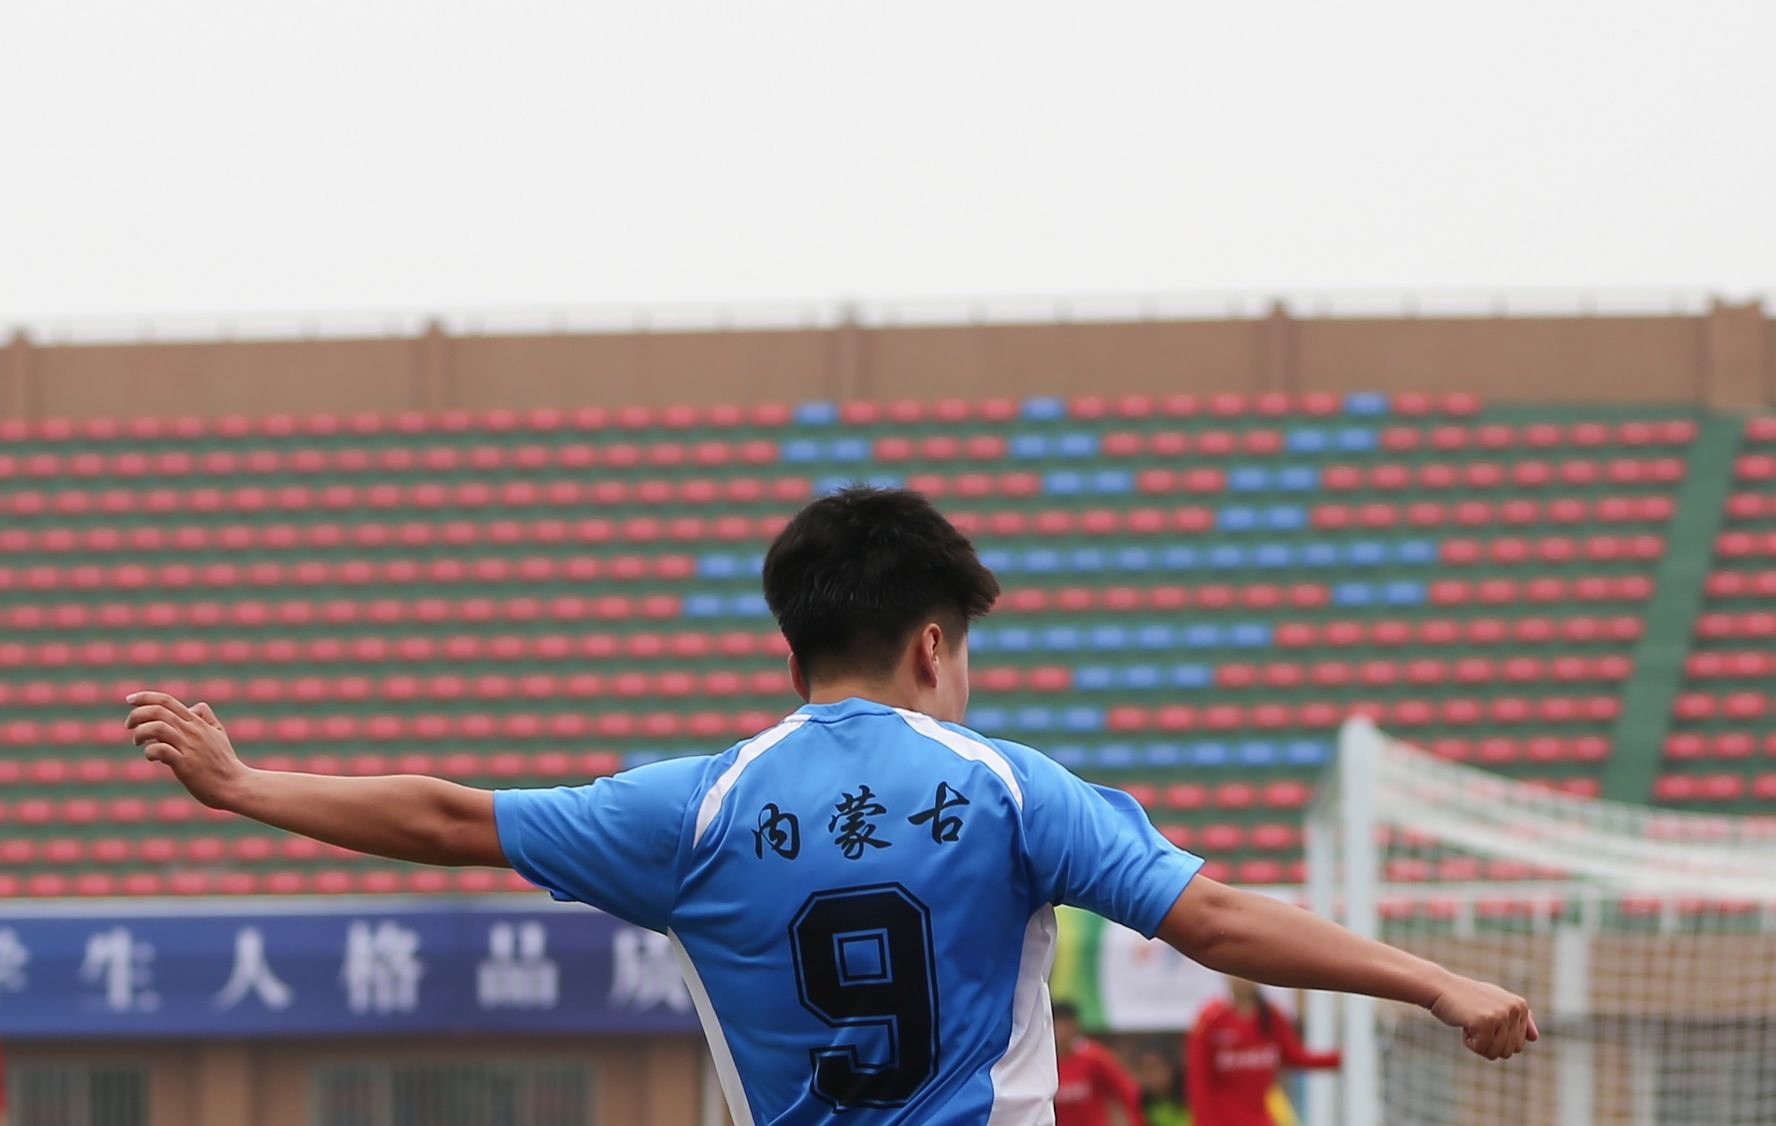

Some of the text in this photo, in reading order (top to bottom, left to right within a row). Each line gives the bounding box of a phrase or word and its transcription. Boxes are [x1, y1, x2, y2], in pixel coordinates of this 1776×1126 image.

[751, 780, 970, 861] 内蒙古
[787, 881, 940, 1114] 9
